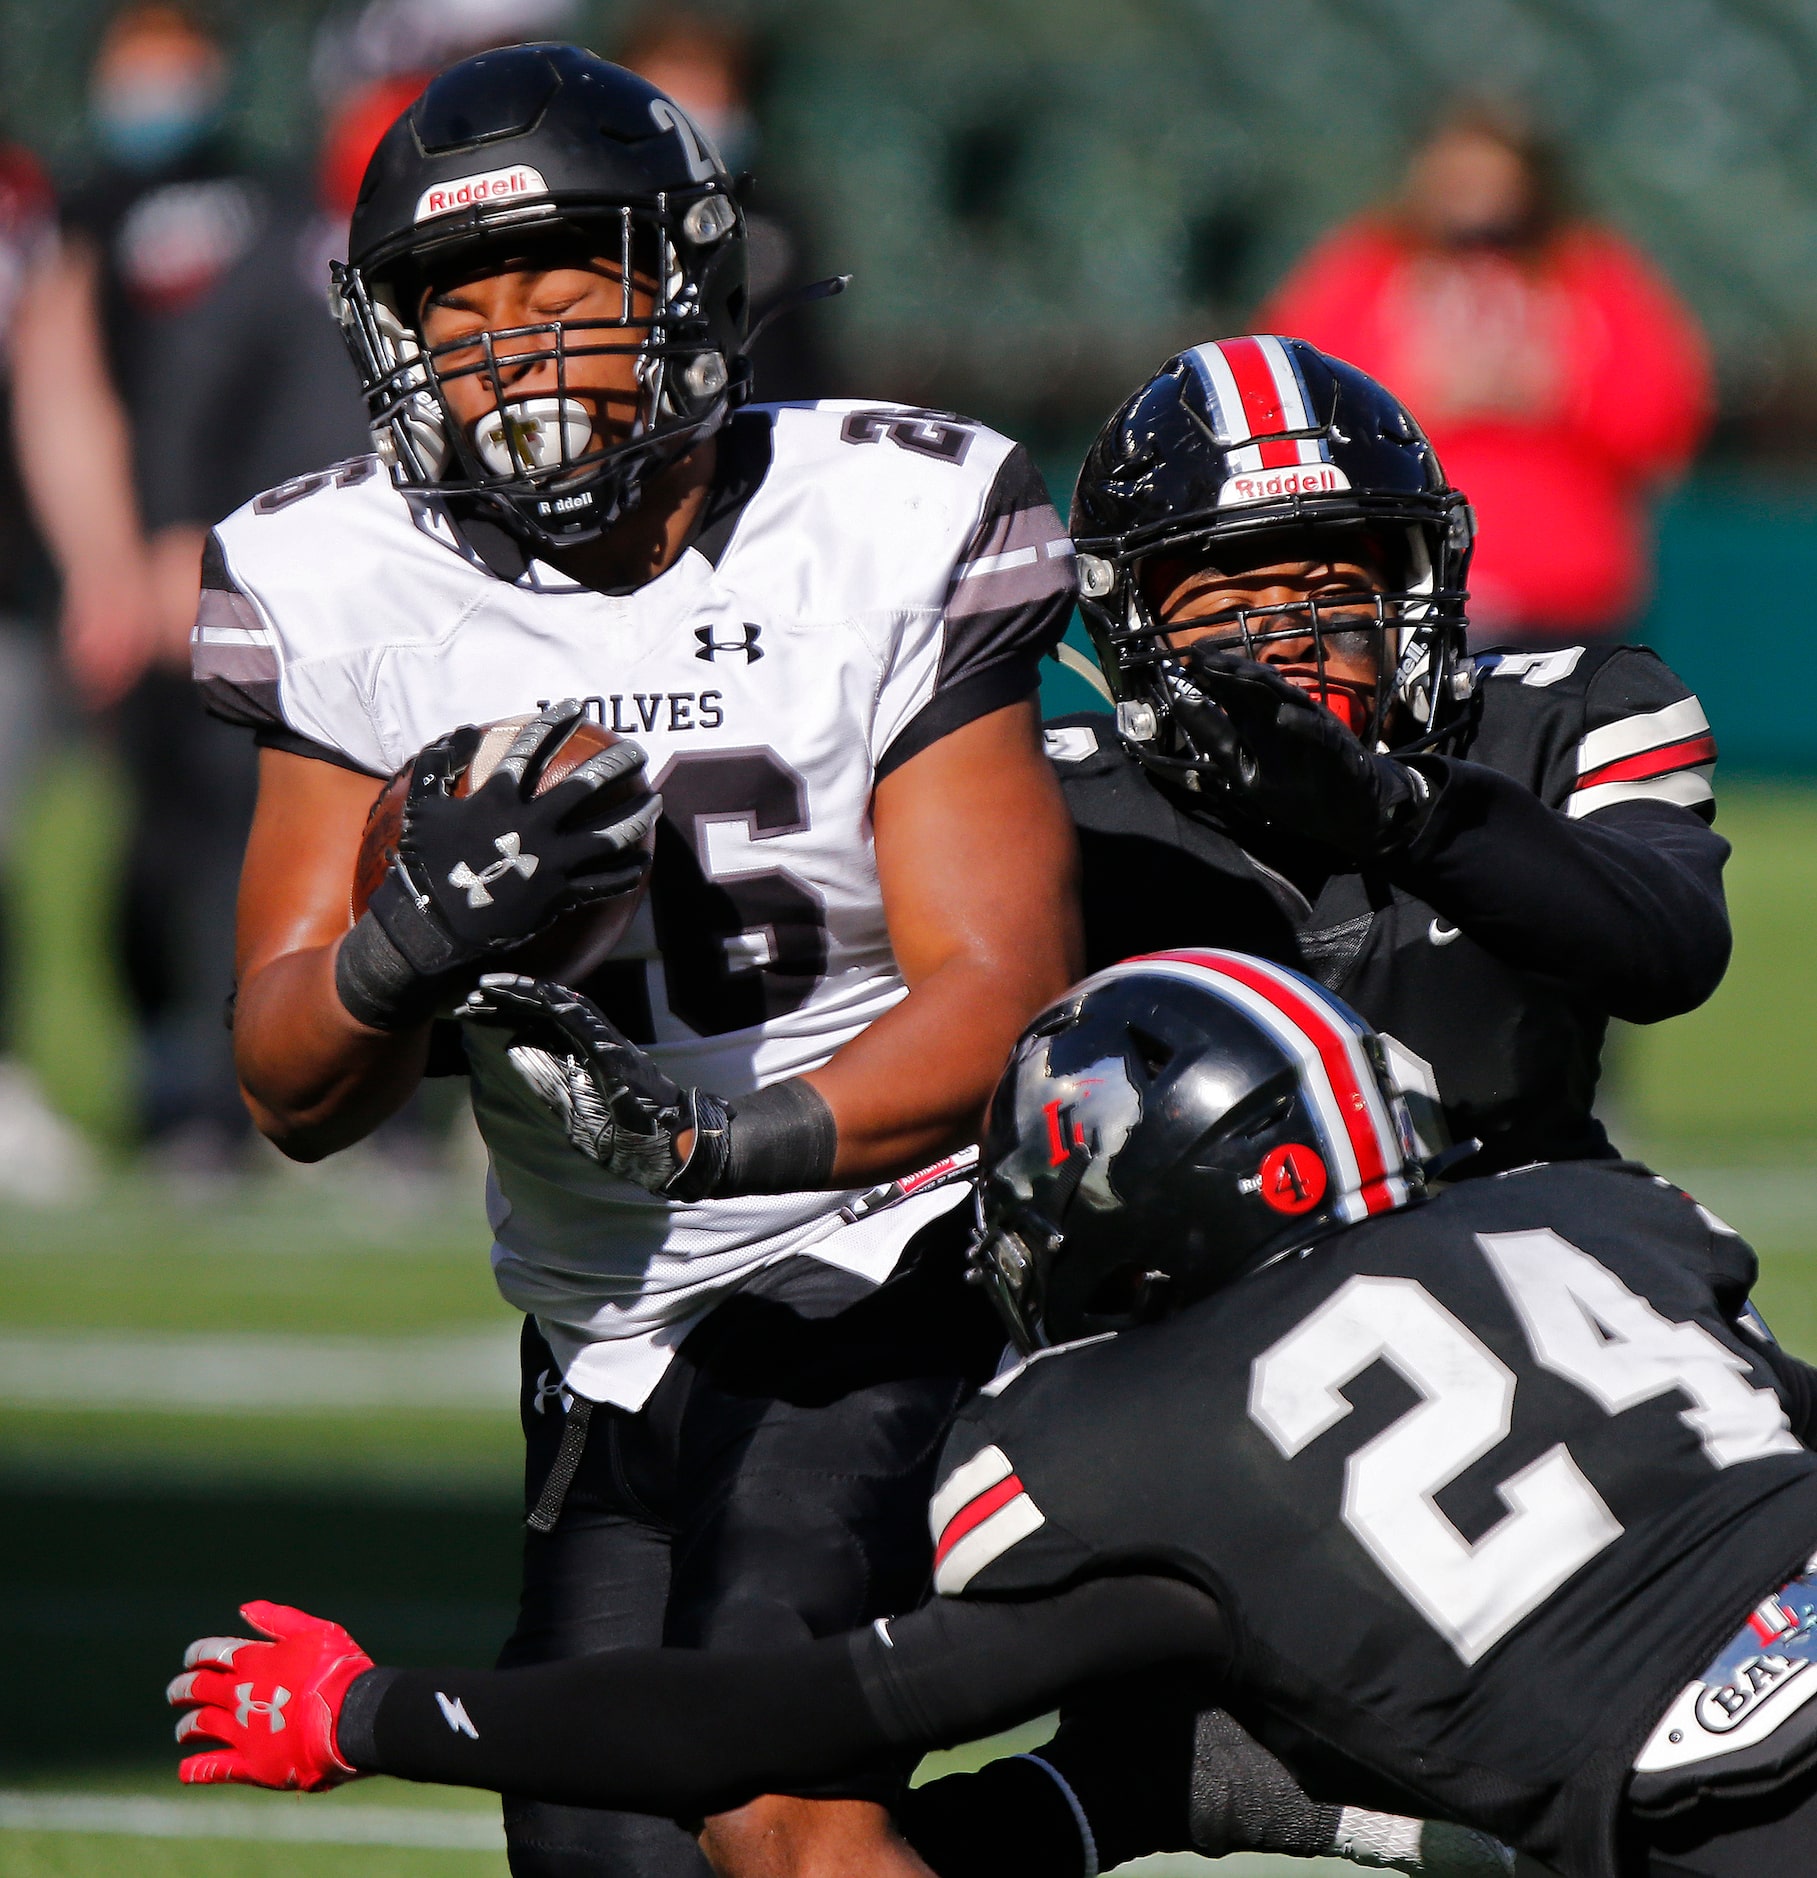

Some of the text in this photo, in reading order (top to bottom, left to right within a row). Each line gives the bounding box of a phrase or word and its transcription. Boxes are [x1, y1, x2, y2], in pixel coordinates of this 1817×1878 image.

[429, 172, 527, 212] Riddell
[1235, 469, 1336, 499] Riddell
[537, 690, 723, 732] OLVES
[1249, 1228, 1804, 1667] 24
